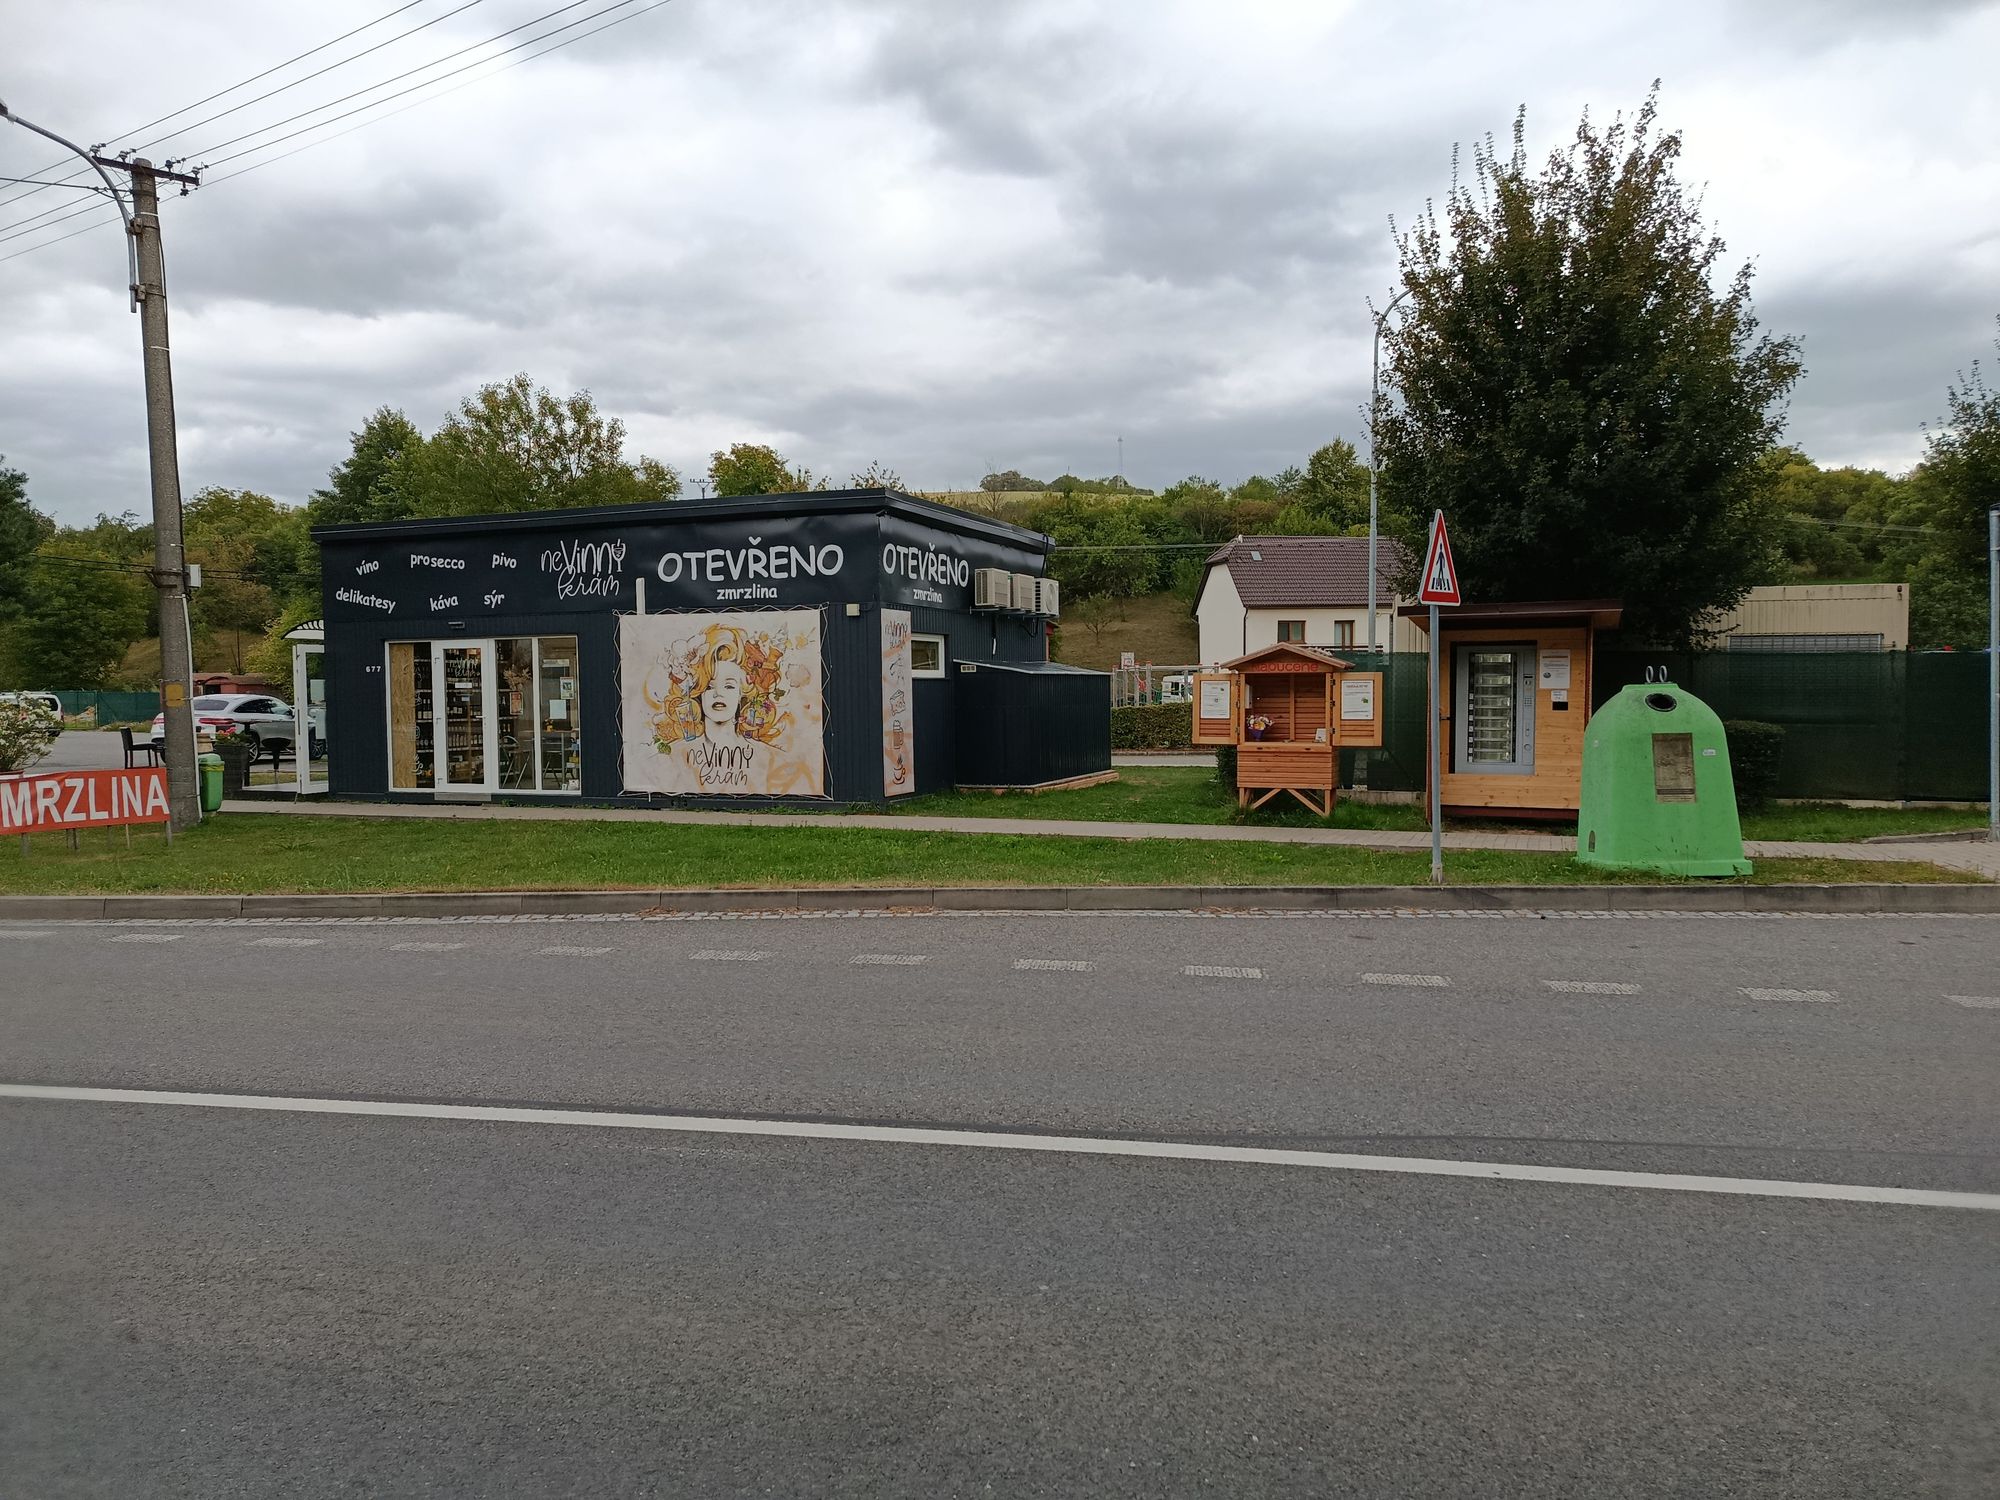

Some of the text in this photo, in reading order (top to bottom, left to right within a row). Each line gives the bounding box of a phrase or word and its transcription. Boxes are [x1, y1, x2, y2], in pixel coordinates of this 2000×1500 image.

[355, 552, 517, 576] víno prosecco pivo
[657, 536, 845, 583] OTEVŘENO
[882, 542, 970, 588] OTEVŘENO
[335, 587, 505, 615] delikatesy káva sýr
[716, 583, 778, 600] zmrzlina
[912, 587, 943, 603] zmrzlina
[365, 665, 381, 673] 677
[0, 774, 170, 828] MRZLINA
